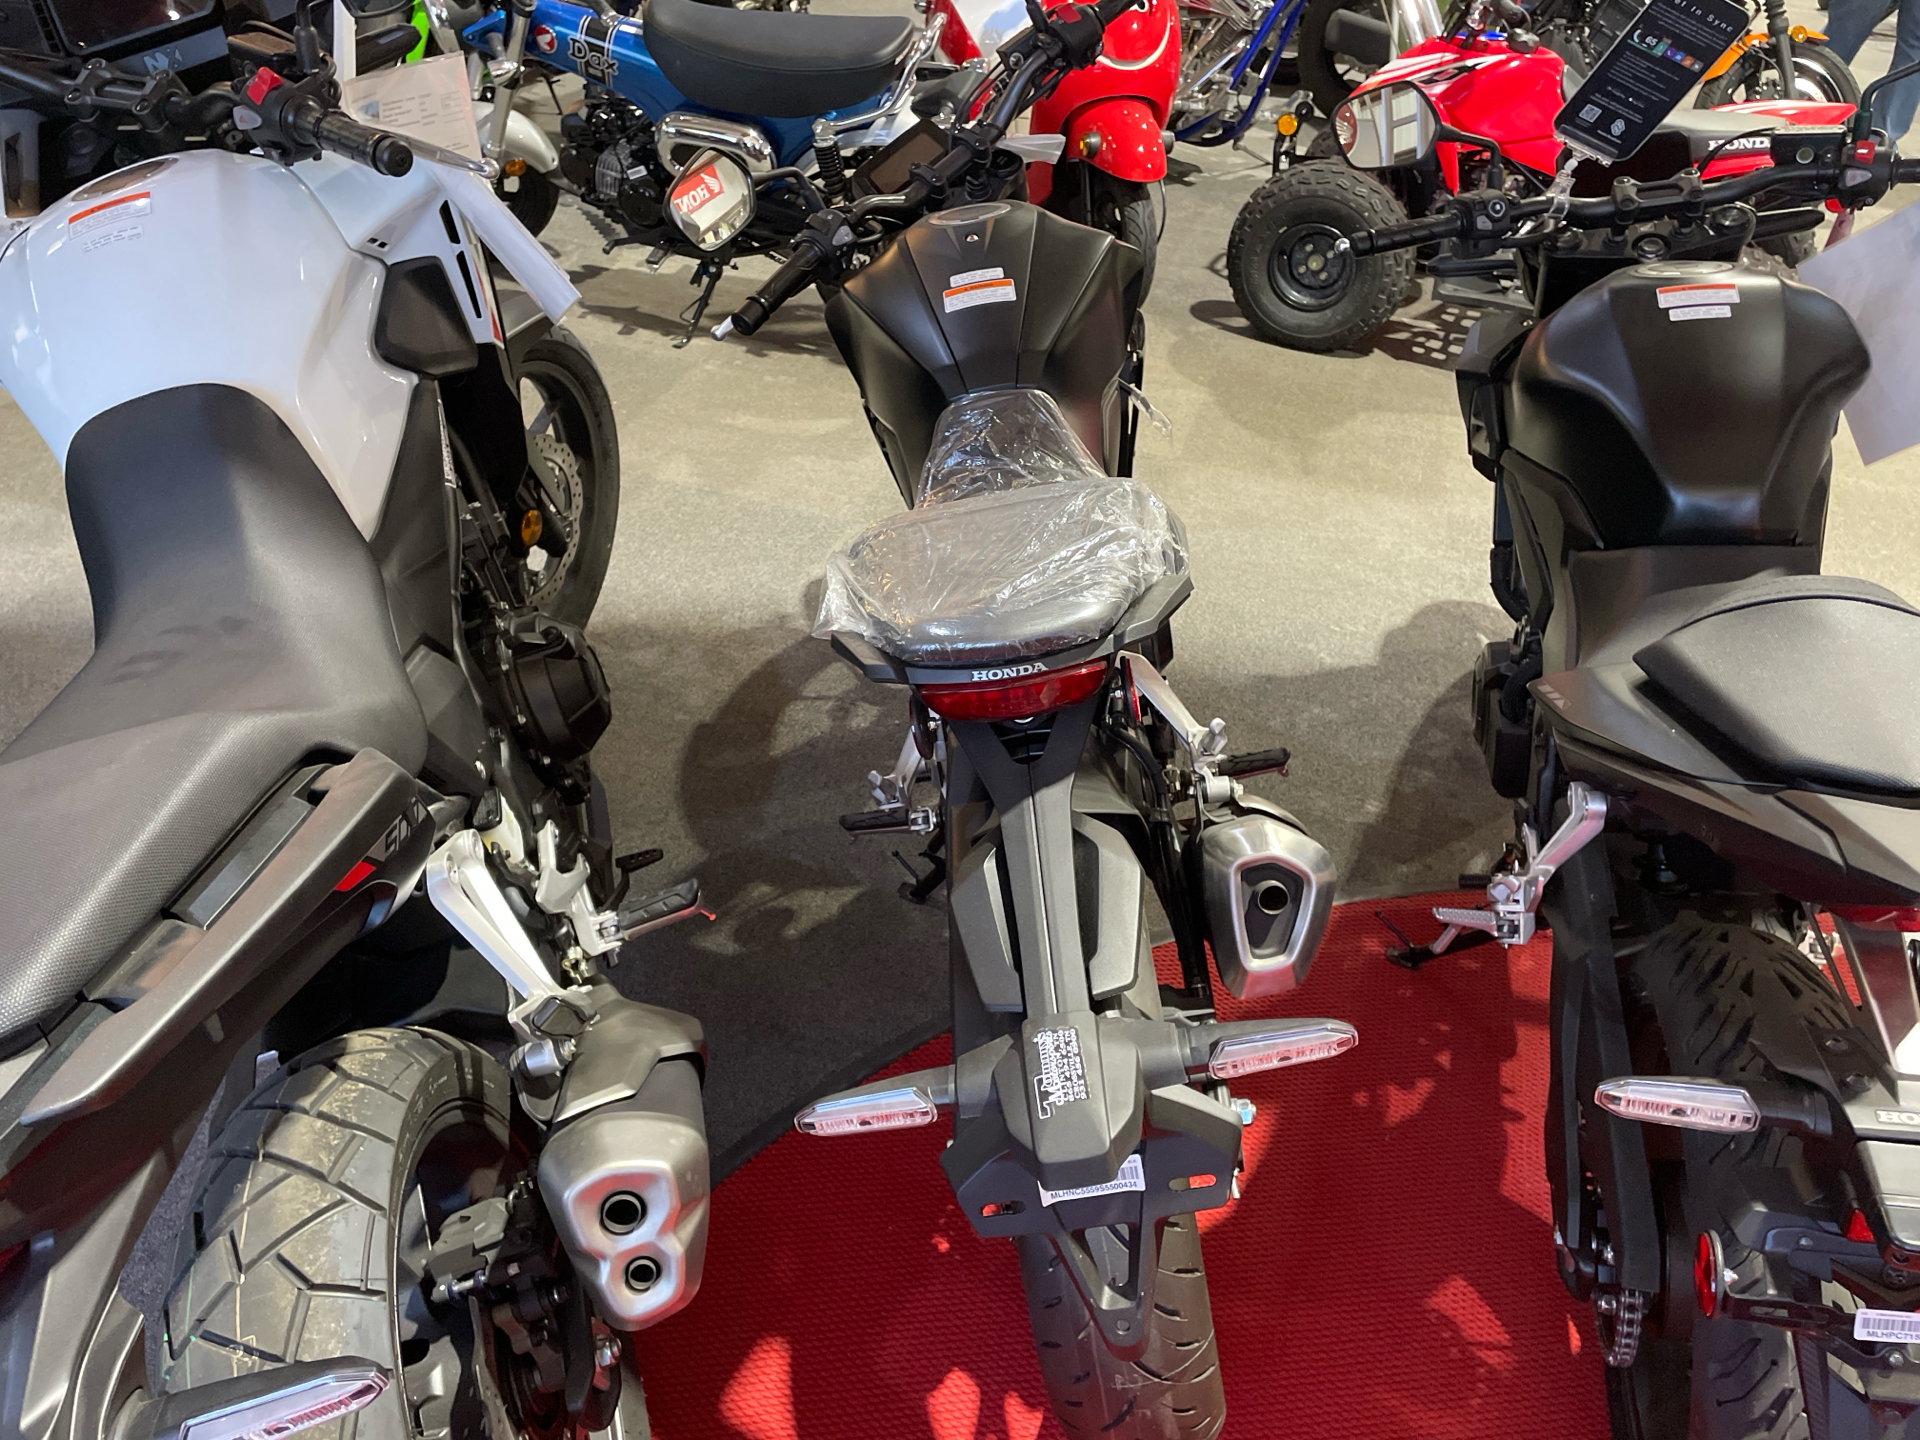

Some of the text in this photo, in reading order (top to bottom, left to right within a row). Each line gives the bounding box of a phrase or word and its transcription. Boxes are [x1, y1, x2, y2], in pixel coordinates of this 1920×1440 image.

[1690, 6, 1702, 16] In
[1706, 14, 1734, 33] Sync
[1645, 36, 1659, 46] 65
[568, 36, 619, 76] Dax
[1707, 137, 1771, 151] HOND
[972, 662, 1049, 681] HONDA
[1053, 1033, 1059, 1047] TN
[1058, 1030, 1067, 1055] 6500
[1064, 1030, 1071, 1042] TN
[1033, 1032, 1055, 1119] Tommy's
[1050, 1181, 1137, 1200] MLHNC5559S5500434
